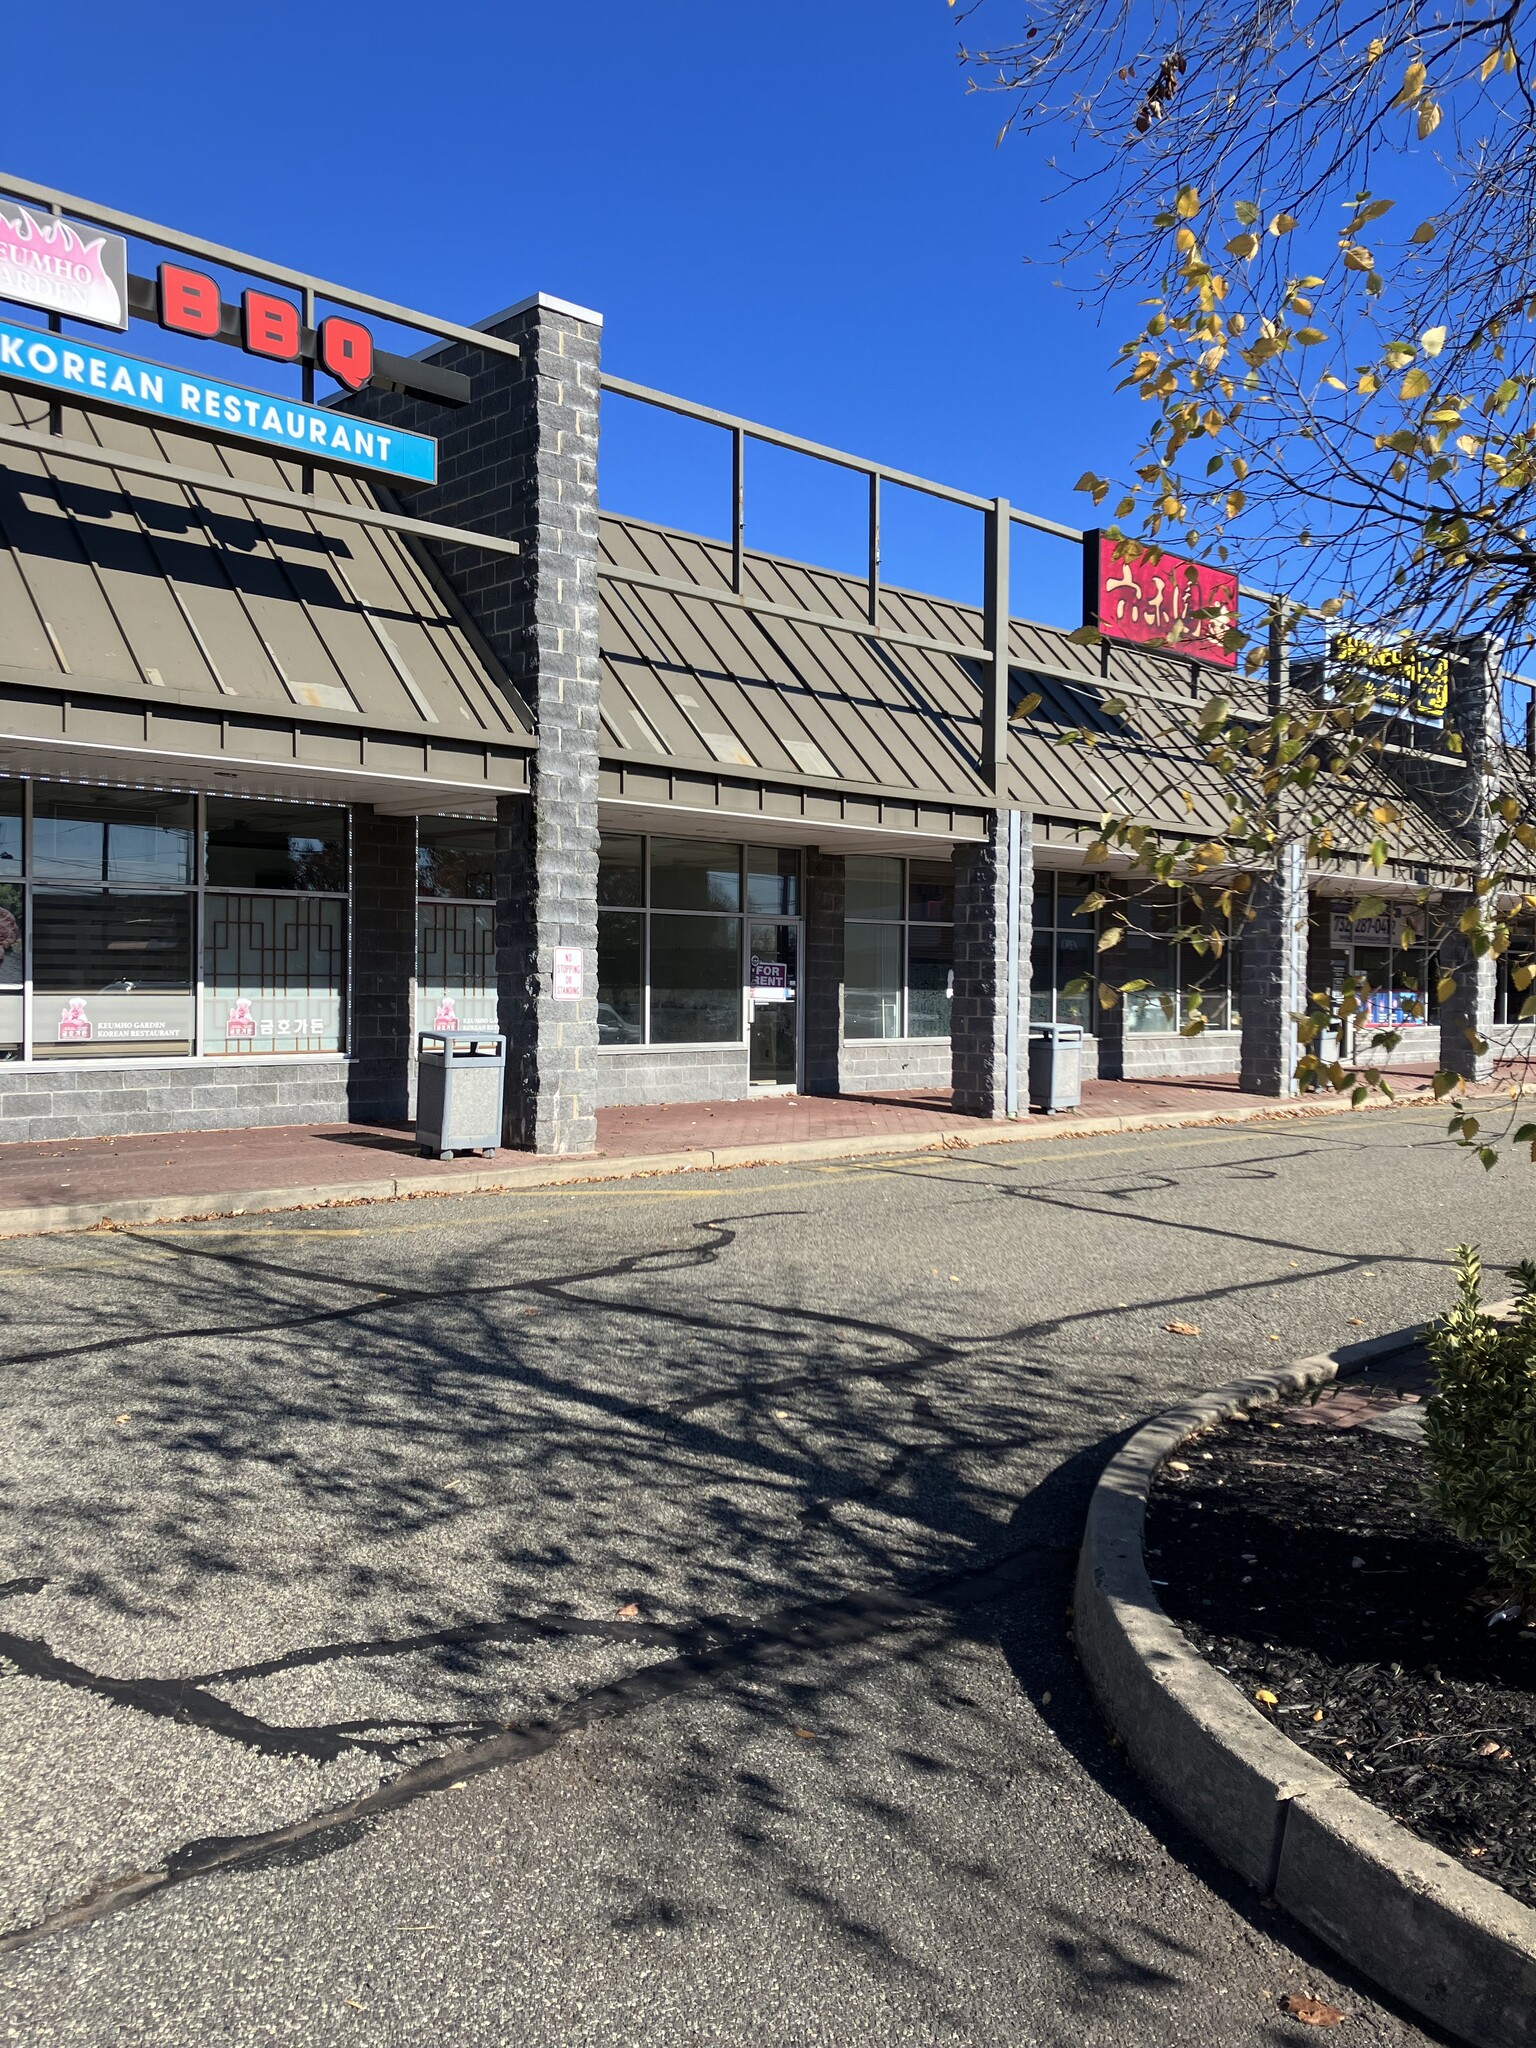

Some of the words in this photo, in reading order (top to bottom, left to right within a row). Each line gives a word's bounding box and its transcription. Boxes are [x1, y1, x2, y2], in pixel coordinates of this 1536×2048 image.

[160, 263, 373, 390] BBQ
[1, 338, 164, 402] KOREAN
[181, 383, 392, 462] RESTAURANT
[565, 953, 572, 962] NO
[557, 965, 580, 974] STOPPING
[756, 966, 780, 976] FOR
[557, 986, 580, 995] STANDING
[98, 1022, 132, 1030] KEUMHO
[134, 1021, 166, 1029] GARDEN
[260, 1018, 324, 1035] 금호가든
[98, 1030, 129, 1038] KOREAN
[131, 1029, 180, 1037] RESTAURANT
